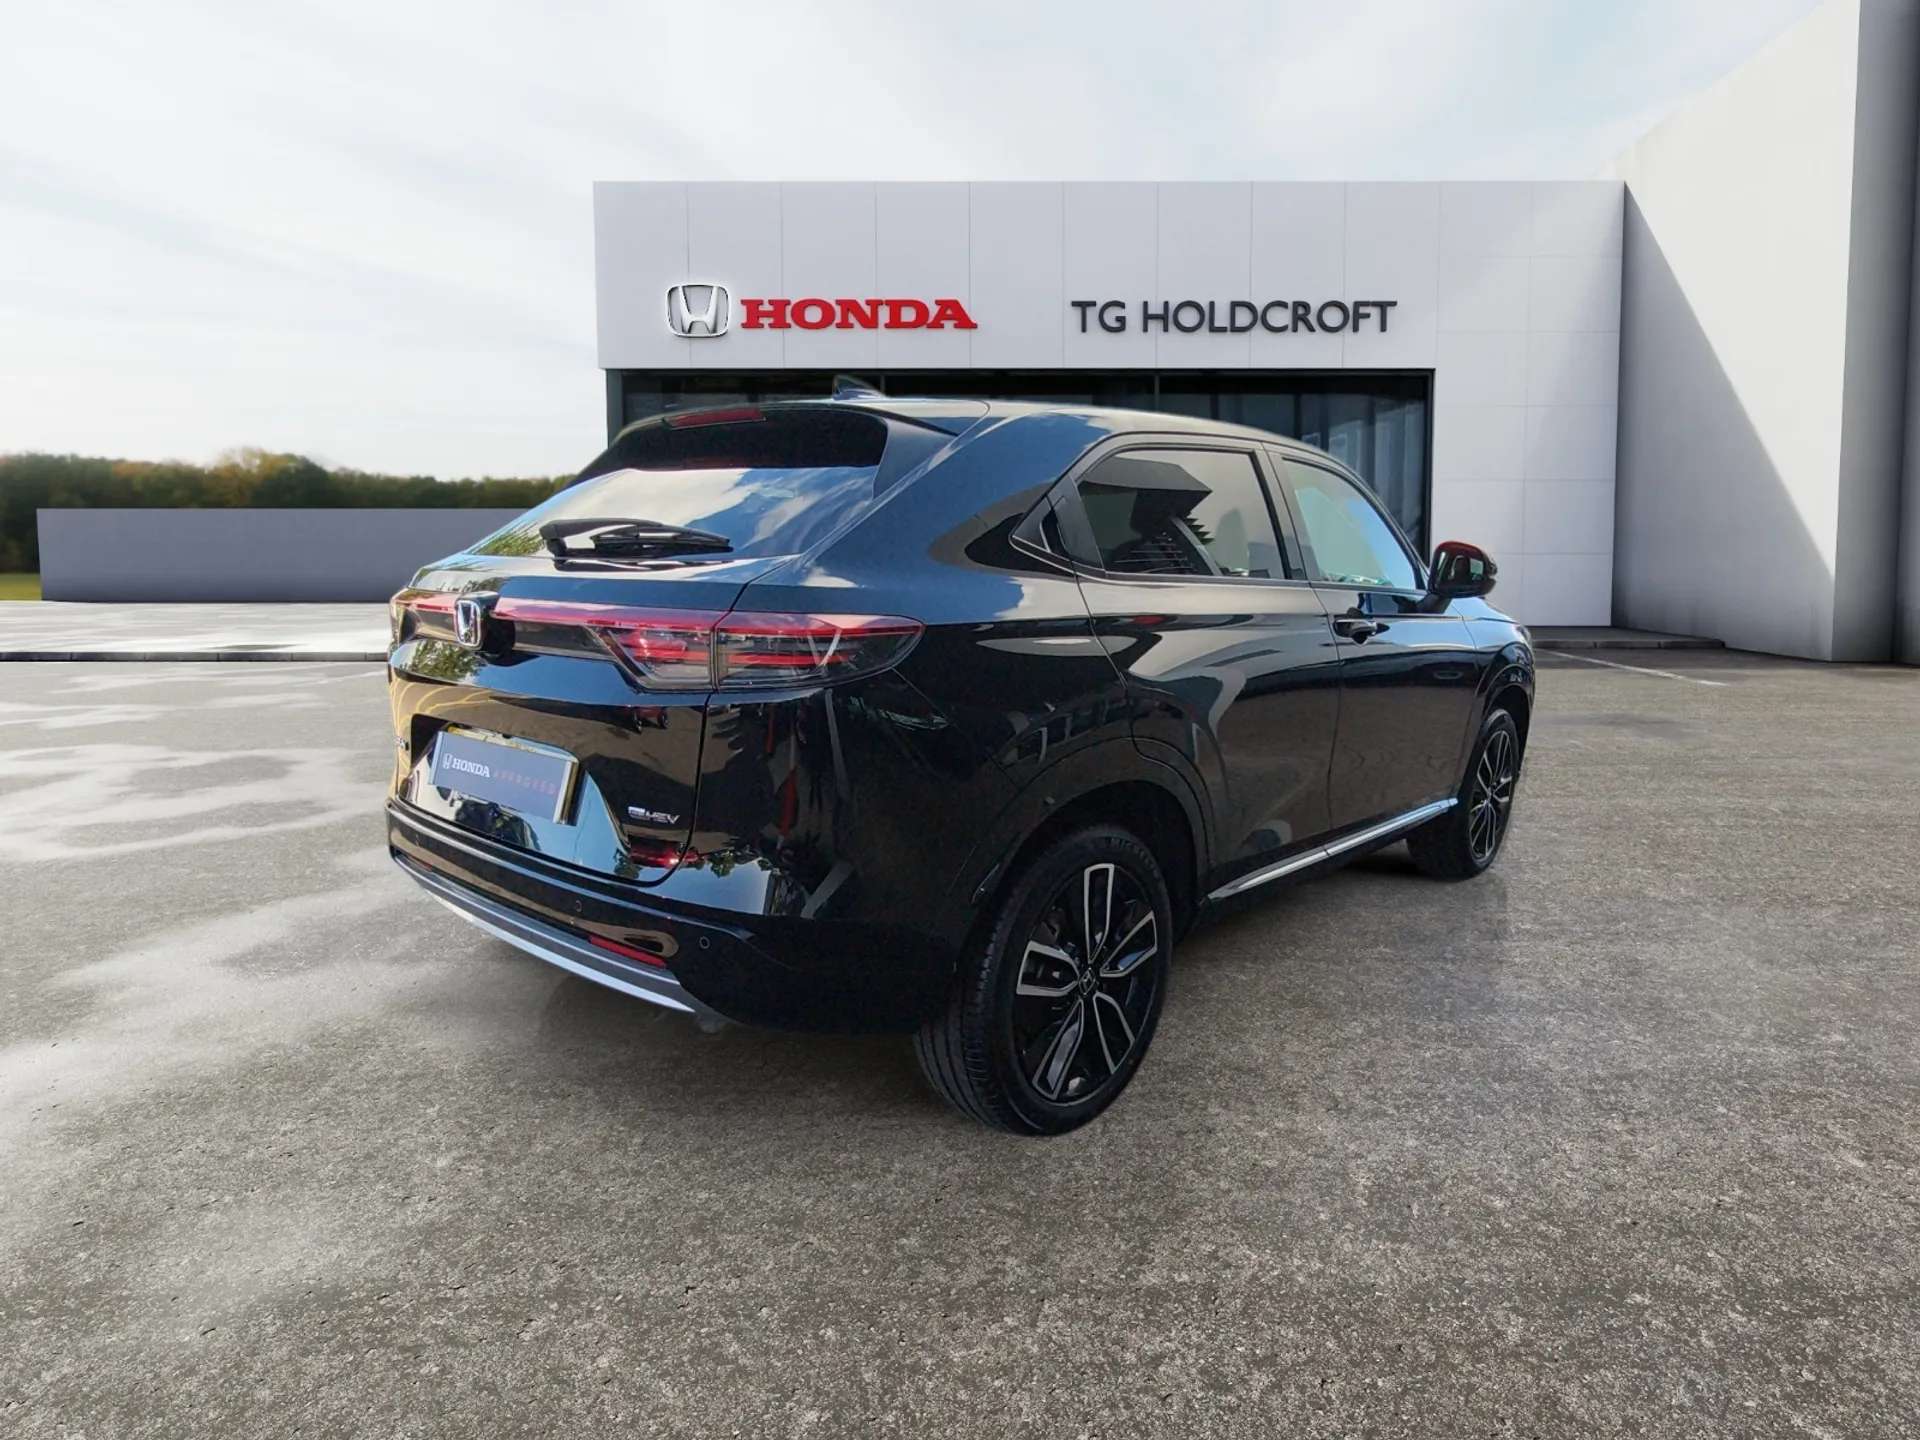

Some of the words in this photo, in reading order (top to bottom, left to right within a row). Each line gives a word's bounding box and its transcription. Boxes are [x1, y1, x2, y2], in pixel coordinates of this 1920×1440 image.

[740, 298, 978, 329] HONDA
[1071, 300, 1127, 333] TG
[1142, 300, 1398, 333] HOLDCROFT
[452, 757, 491, 778] HONDA
